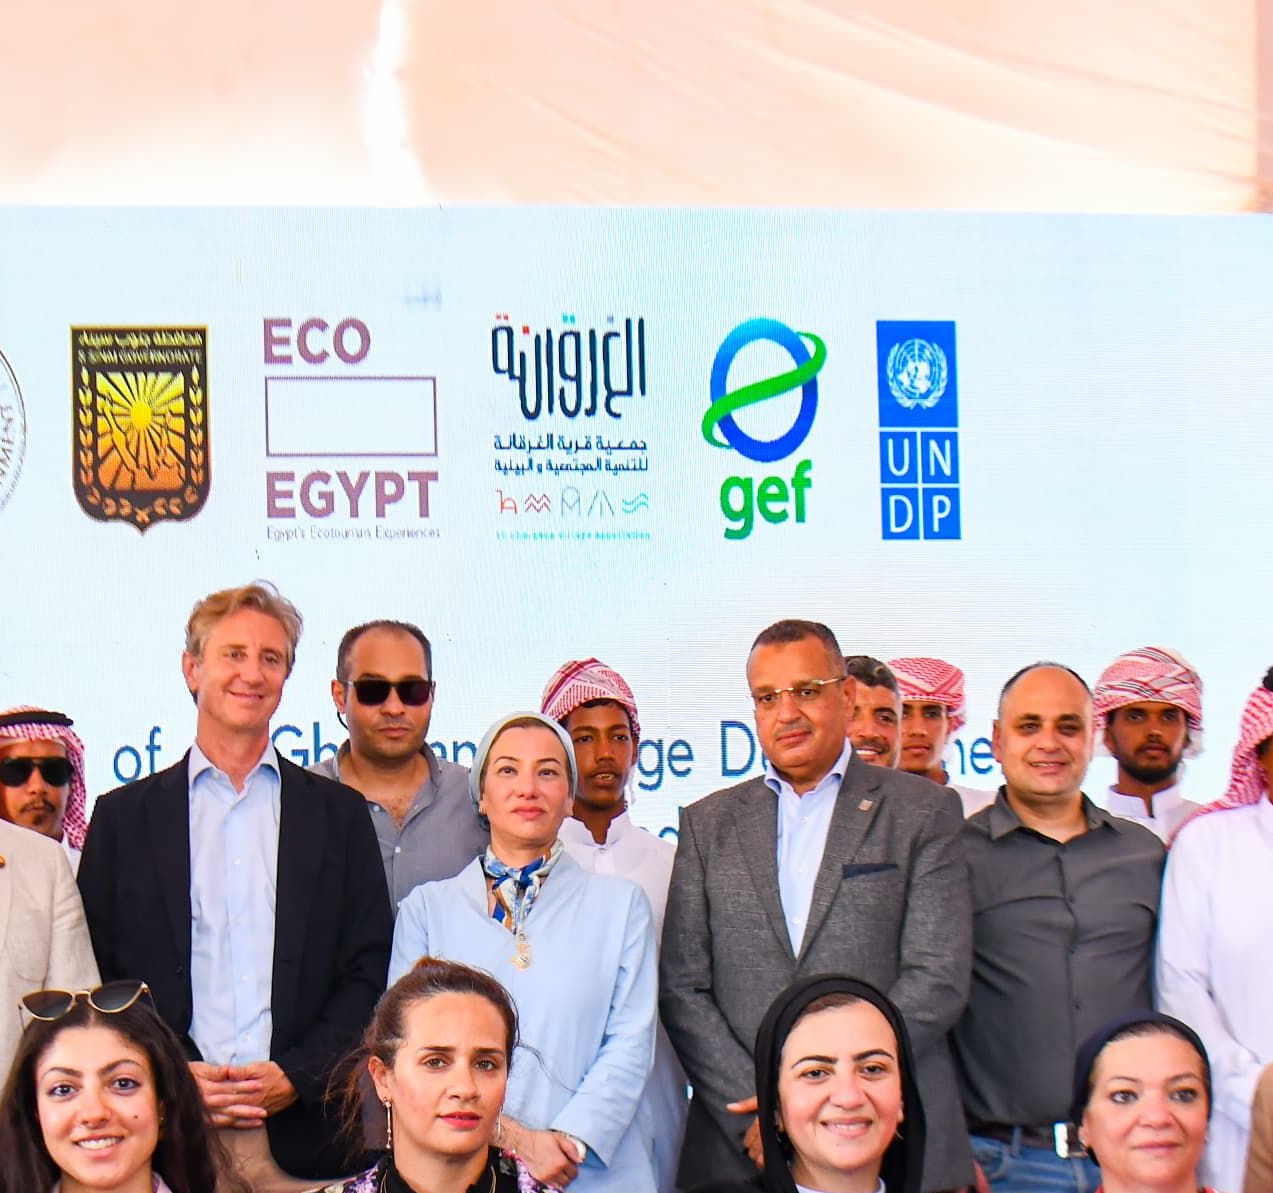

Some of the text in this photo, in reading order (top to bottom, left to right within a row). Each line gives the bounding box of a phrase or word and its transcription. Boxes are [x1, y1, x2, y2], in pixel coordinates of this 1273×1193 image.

[263, 315, 372, 365] ECO
[494, 432, 648, 455] جمعية قرية الغرقانة
[545, 456, 603, 476] المجتمعية
[604, 456, 649, 476] للتنمية
[266, 471, 439, 519] EGYPT
[719, 459, 812, 540] gef
[375, 525, 441, 540] Experiences
[113, 725, 162, 784] of
